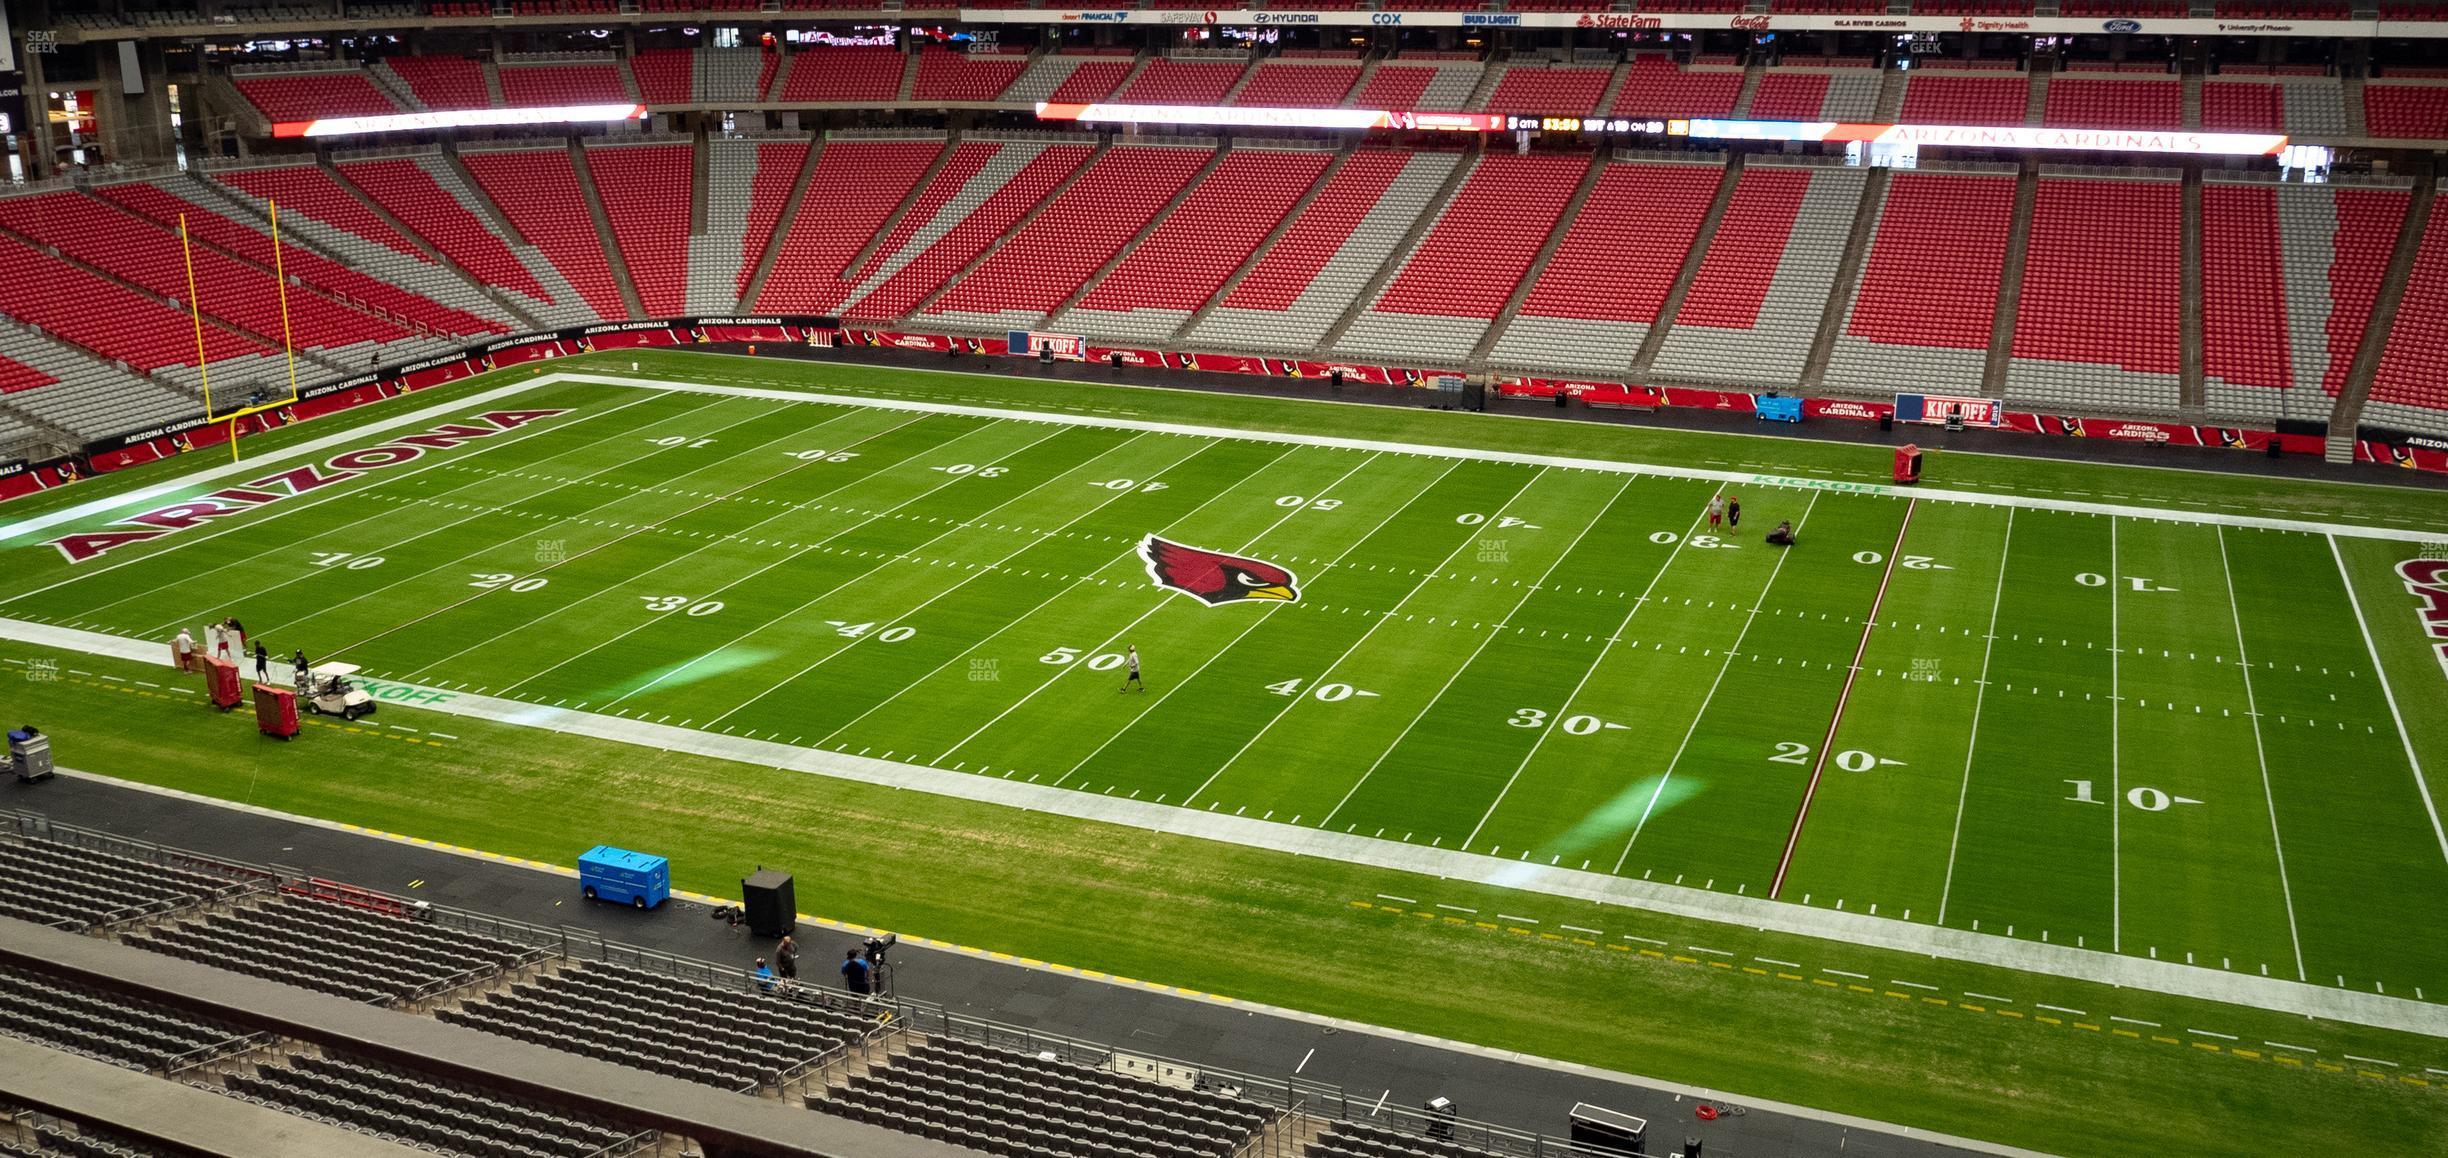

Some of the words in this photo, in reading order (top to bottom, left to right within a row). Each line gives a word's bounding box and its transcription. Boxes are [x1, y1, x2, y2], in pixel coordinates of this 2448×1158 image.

[1081, 12, 1114, 20] FINANCIAL
[1161, 13, 1204, 24] SAFEWAY
[1272, 14, 1318, 23] HYUNDAI
[1372, 13, 1401, 25] COX
[1464, 15, 1486, 24] BUD
[1487, 15, 1519, 25] LIGHT
[1977, 21, 2003, 30] Dignity
[2004, 21, 2029, 29] Health
[2109, 20, 2135, 32] Ford
[2227, 24, 2257, 32] University
[1519, 120, 1538, 129] QTR
[1631, 122, 1646, 132] ON
[1895, 127, 2018, 144] ARIZONA
[2034, 131, 2202, 150] CARDINALS
[585, 323, 621, 334] ARIZONA
[621, 320, 669, 331] CARDINALS
[487, 339, 515, 352] ARIZONA
[514, 332, 558, 345] CARDINALS
[895, 339, 936, 348] CARDINALS
[401, 360, 431, 375] ARIZONA
[431, 351, 467, 368] CARDINALS
[1101, 354, 1145, 363] CAINALS
[1320, 370, 1367, 380] CANALS
[304, 384, 337, 398] ARIZONA
[338, 373, 378, 391] CARDINALS
[1565, 383, 1596, 391] ARIZONA
[1819, 407, 1875, 418] CARDINALS
[1830, 402, 1864, 411] ARIZONA
[1926, 400, 1988, 421] KICOFF
[125, 428, 164, 444] ARIZONA
[2121, 424, 2159, 432] ARIZONA
[656, 435, 718, 449] 10
[797, 448, 860, 463] 20
[945, 463, 1010, 479] 30
[38, 408, 576, 564] ARIZONA
[1105, 478, 1170, 493] 40
[1752, 475, 1892, 493] KICKOFF
[1275, 494, 1344, 511] 50
[1456, 512, 1526, 529] 40
[1649, 531, 1722, 549] 30
[309, 552, 386, 570] 10
[1852, 550, 1935, 570] 20
[468, 573, 549, 593] 20
[2074, 572, 2160, 592] 10
[645, 595, 725, 617] 30
[835, 621, 917, 643] 40
[1039, 646, 1125, 672] 50
[1264, 677, 1355, 702] 40
[1506, 708, 1602, 737] 30
[1767, 741, 1877, 773] 20
[2062, 778, 2171, 812] 10
